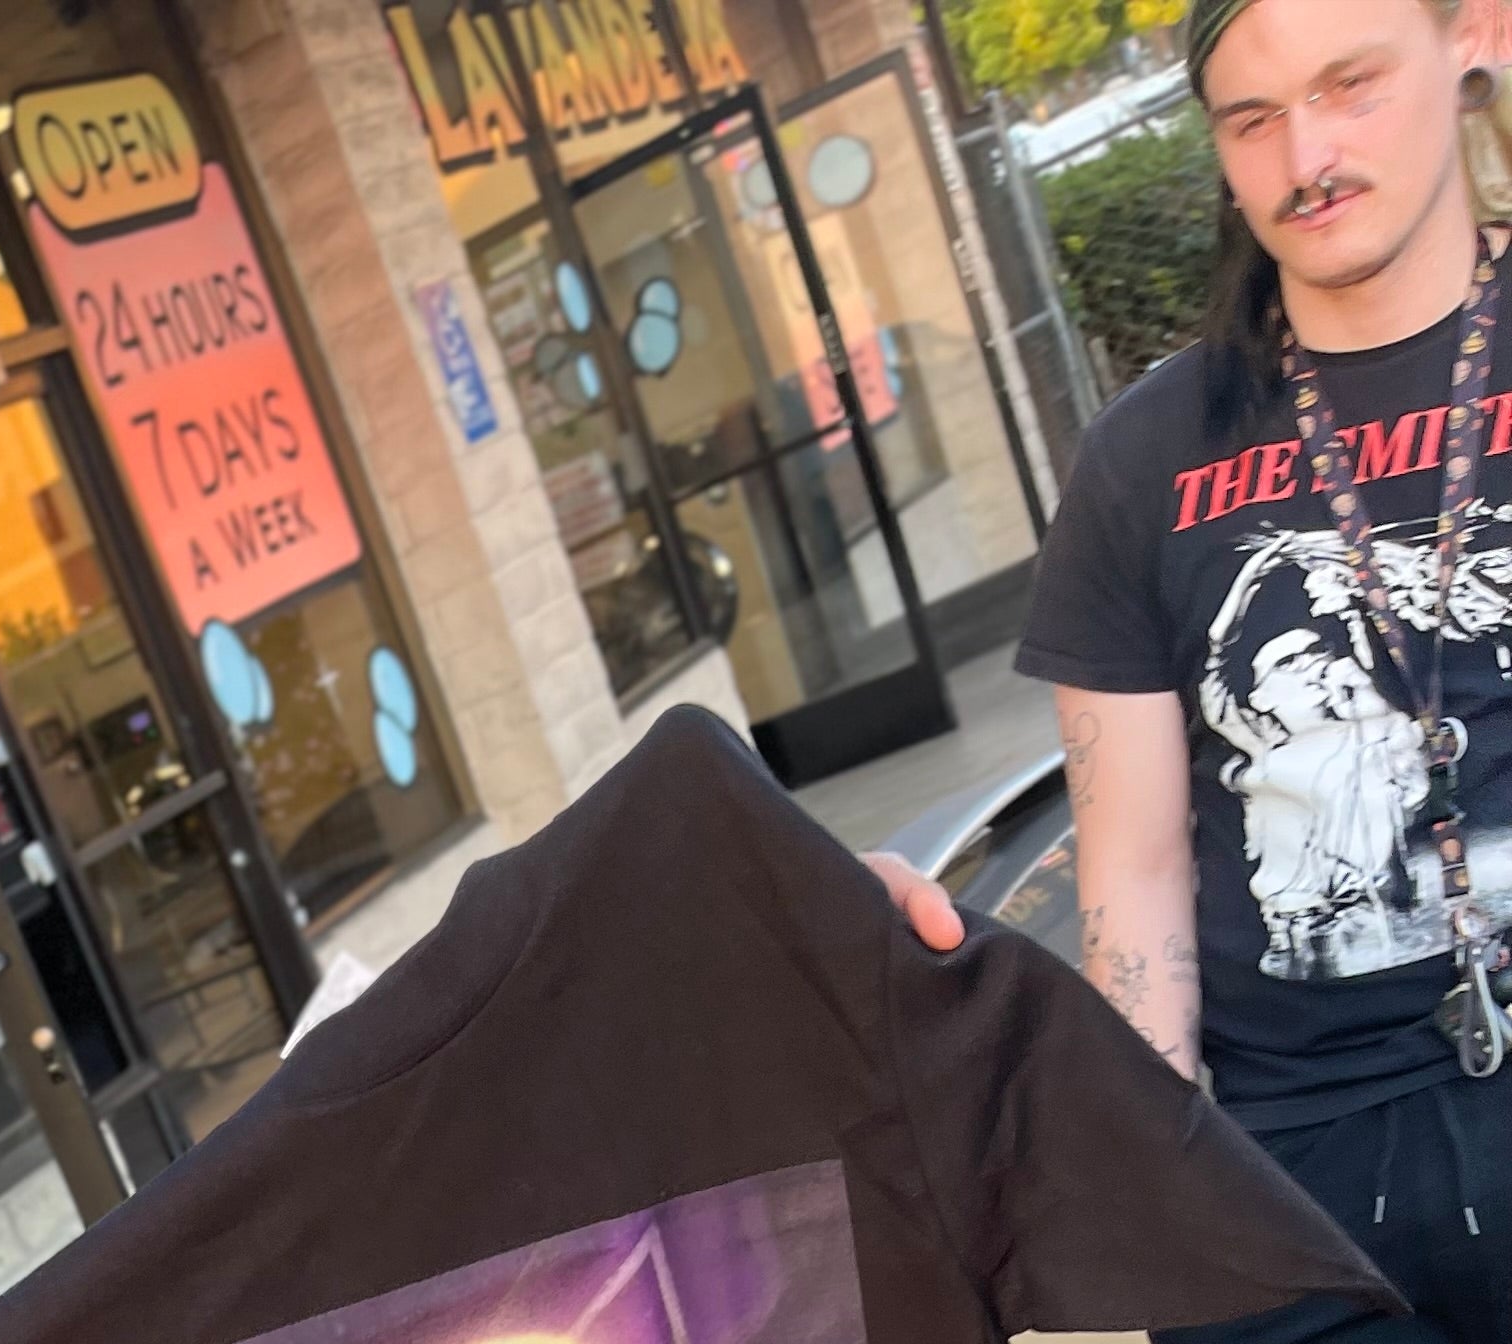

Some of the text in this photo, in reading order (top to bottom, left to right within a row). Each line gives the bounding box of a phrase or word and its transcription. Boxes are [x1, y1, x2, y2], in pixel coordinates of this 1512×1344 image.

[386, 0, 750, 160] LAVANDEIA
[36, 107, 182, 200] OPEN
[75, 264, 269, 387] 24 HOURS
[131, 388, 300, 511] 7 DAYS
[1172, 438, 1303, 533] THE
[189, 489, 317, 590] A WEEK
